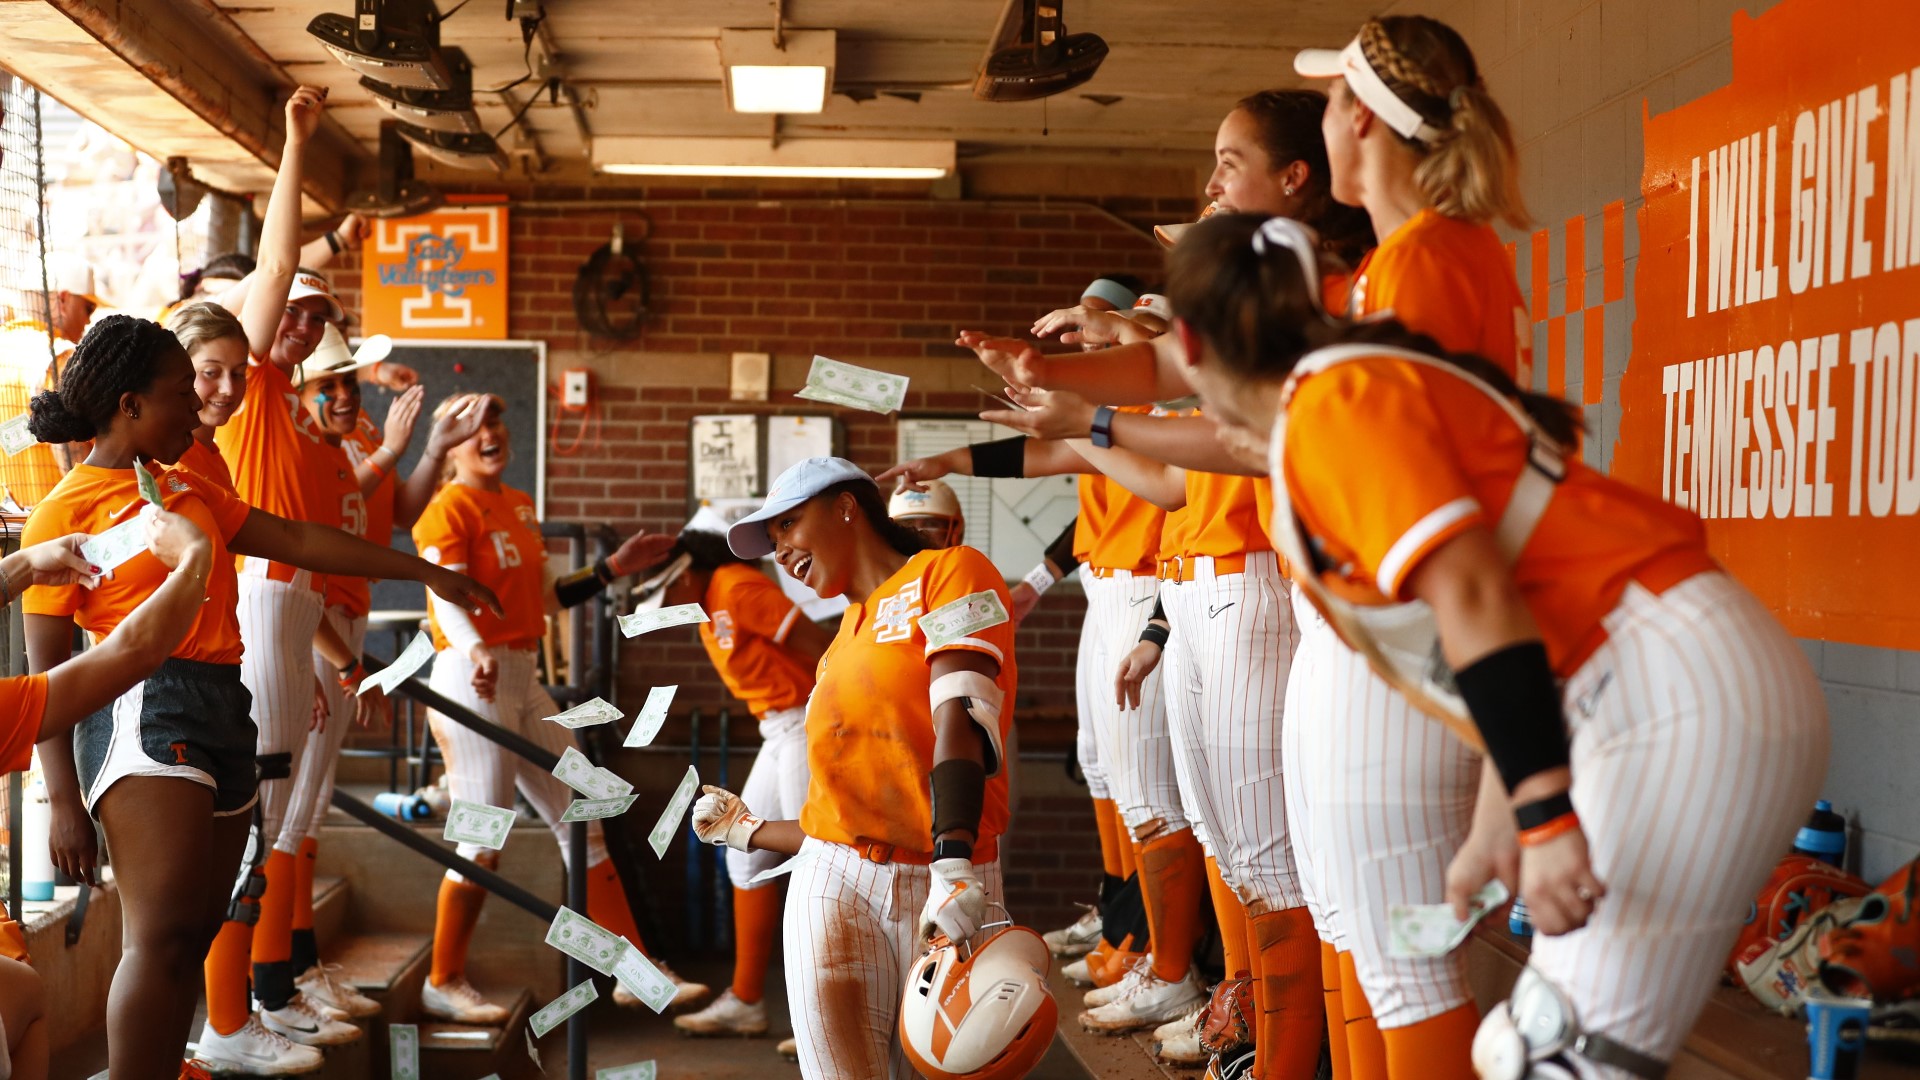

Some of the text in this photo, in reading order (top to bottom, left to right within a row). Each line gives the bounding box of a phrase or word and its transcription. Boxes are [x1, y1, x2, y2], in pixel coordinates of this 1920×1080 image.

[1687, 156, 1700, 318] I
[1708, 125, 1779, 313] WILL
[1788, 84, 1878, 294] GIVE
[408, 232, 465, 272] Lady
[377, 262, 496, 297] Volunteers
[1663, 333, 1840, 519] TENNESSEE
[490, 530, 522, 570] 15
